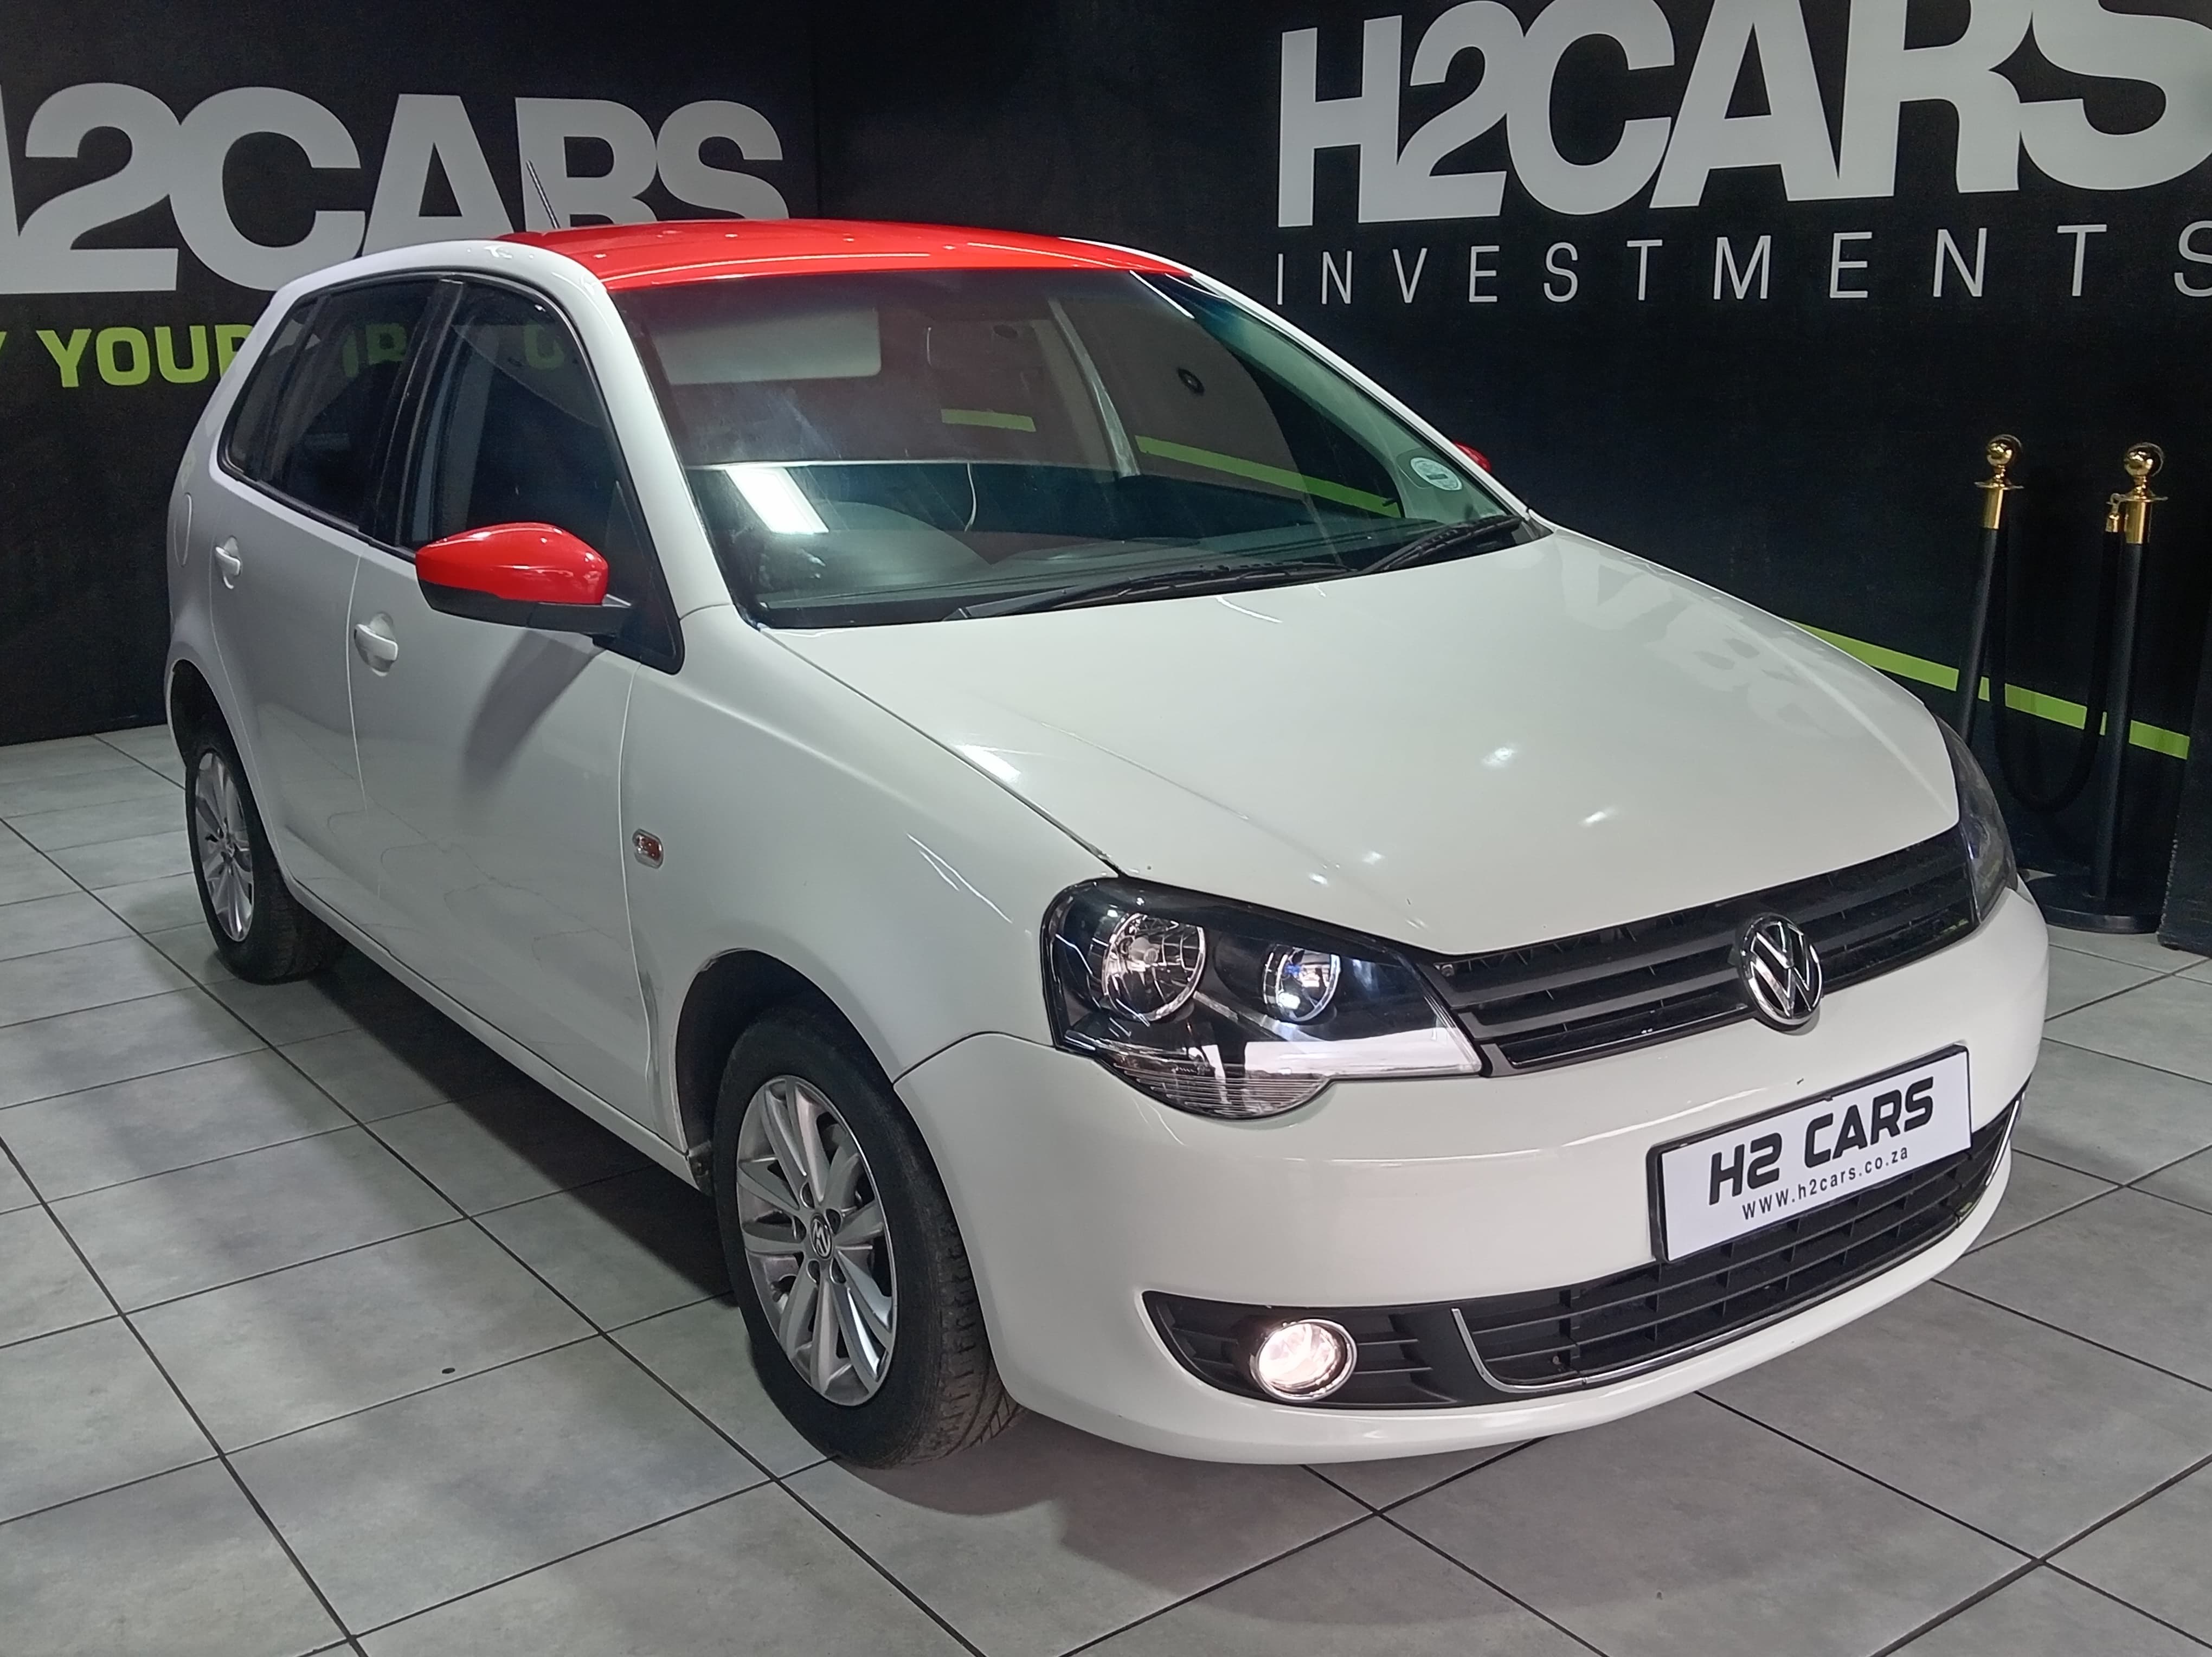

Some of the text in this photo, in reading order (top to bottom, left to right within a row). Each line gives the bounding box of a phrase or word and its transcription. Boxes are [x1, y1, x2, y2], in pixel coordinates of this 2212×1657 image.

[1277, 0, 2212, 227] H2CARS
[0, 82, 789, 294] 2CARS
[1277, 220, 2212, 304] INVESTMENTS
[1709, 1076, 1933, 1205] H2 CARS
[1742, 1147, 1908, 1220] www.h2cars.co.za
